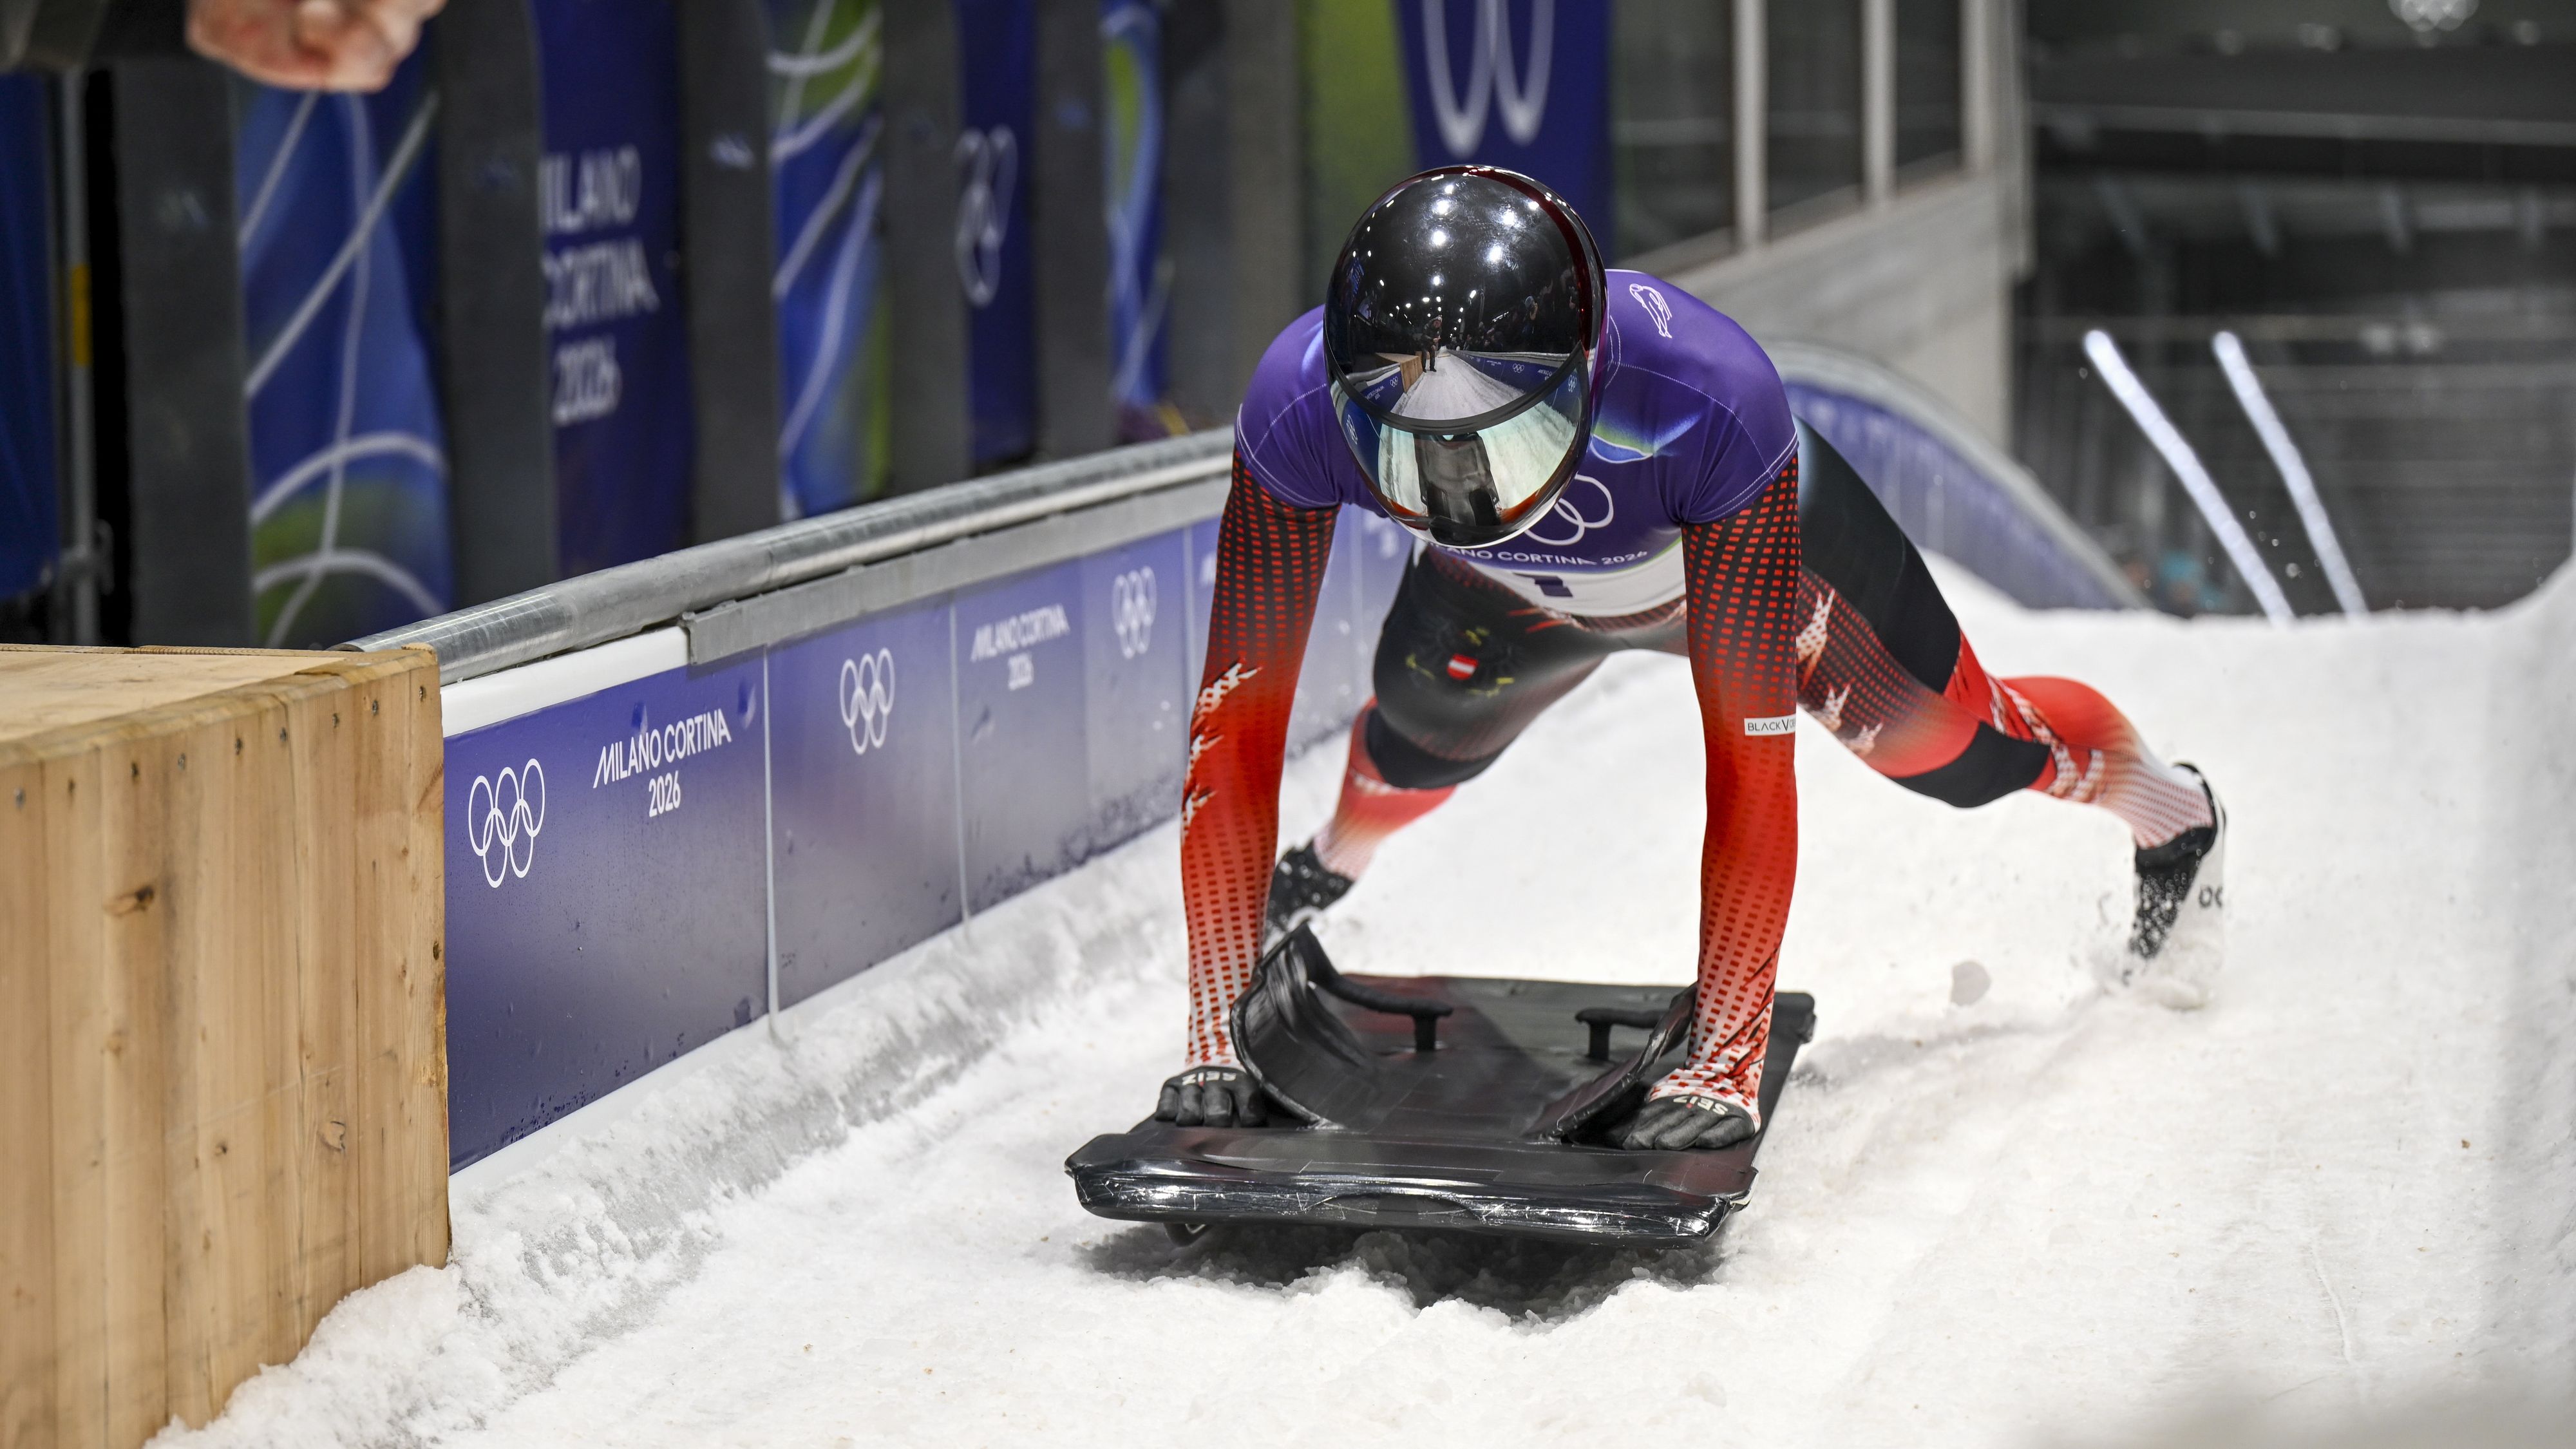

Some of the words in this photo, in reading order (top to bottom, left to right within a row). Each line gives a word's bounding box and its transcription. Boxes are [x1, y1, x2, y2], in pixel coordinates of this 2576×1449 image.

[1497, 551, 1597, 565] CORTINA
[1602, 551, 1647, 565] 2026
[970, 616, 1019, 663] MILANO
[1019, 603, 1070, 647] CORTINA
[1008, 652, 1034, 690] 2026
[593, 729, 661, 788] MILANO
[664, 708, 732, 763] CORTINA
[649, 770, 681, 817] 2026
